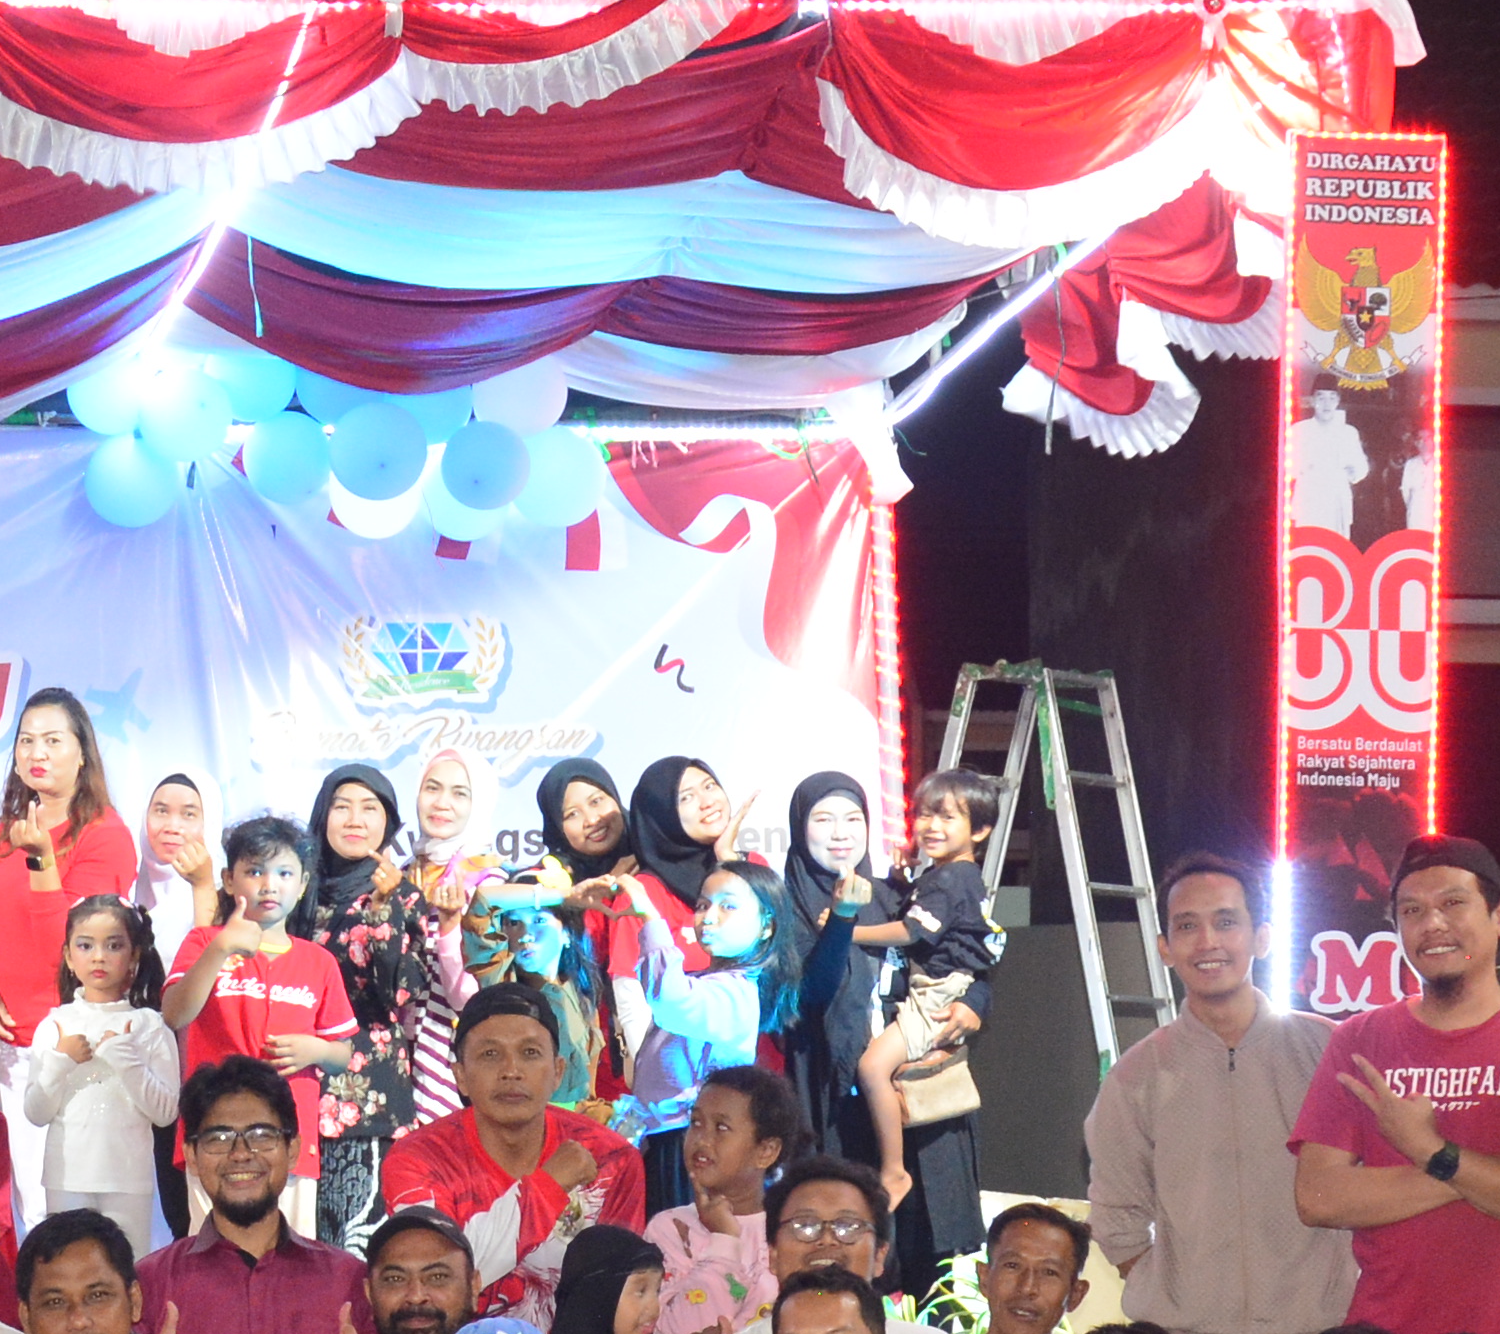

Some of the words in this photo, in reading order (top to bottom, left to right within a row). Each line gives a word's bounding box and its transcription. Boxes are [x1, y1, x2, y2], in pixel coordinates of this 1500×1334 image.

[1306, 152, 1437, 172] DIRGAHAYU
[1305, 178, 1435, 200] REPUBLIK
[1304, 204, 1435, 225] INDONESIA
[1297, 735, 1351, 750] Bersatu
[1355, 736, 1423, 752] Berdaulat
[1297, 753, 1345, 769] Rakyat
[1348, 754, 1415, 772] Sejahtera
[1296, 771, 1364, 787] Indonesia
[1367, 772, 1400, 790] Maju
